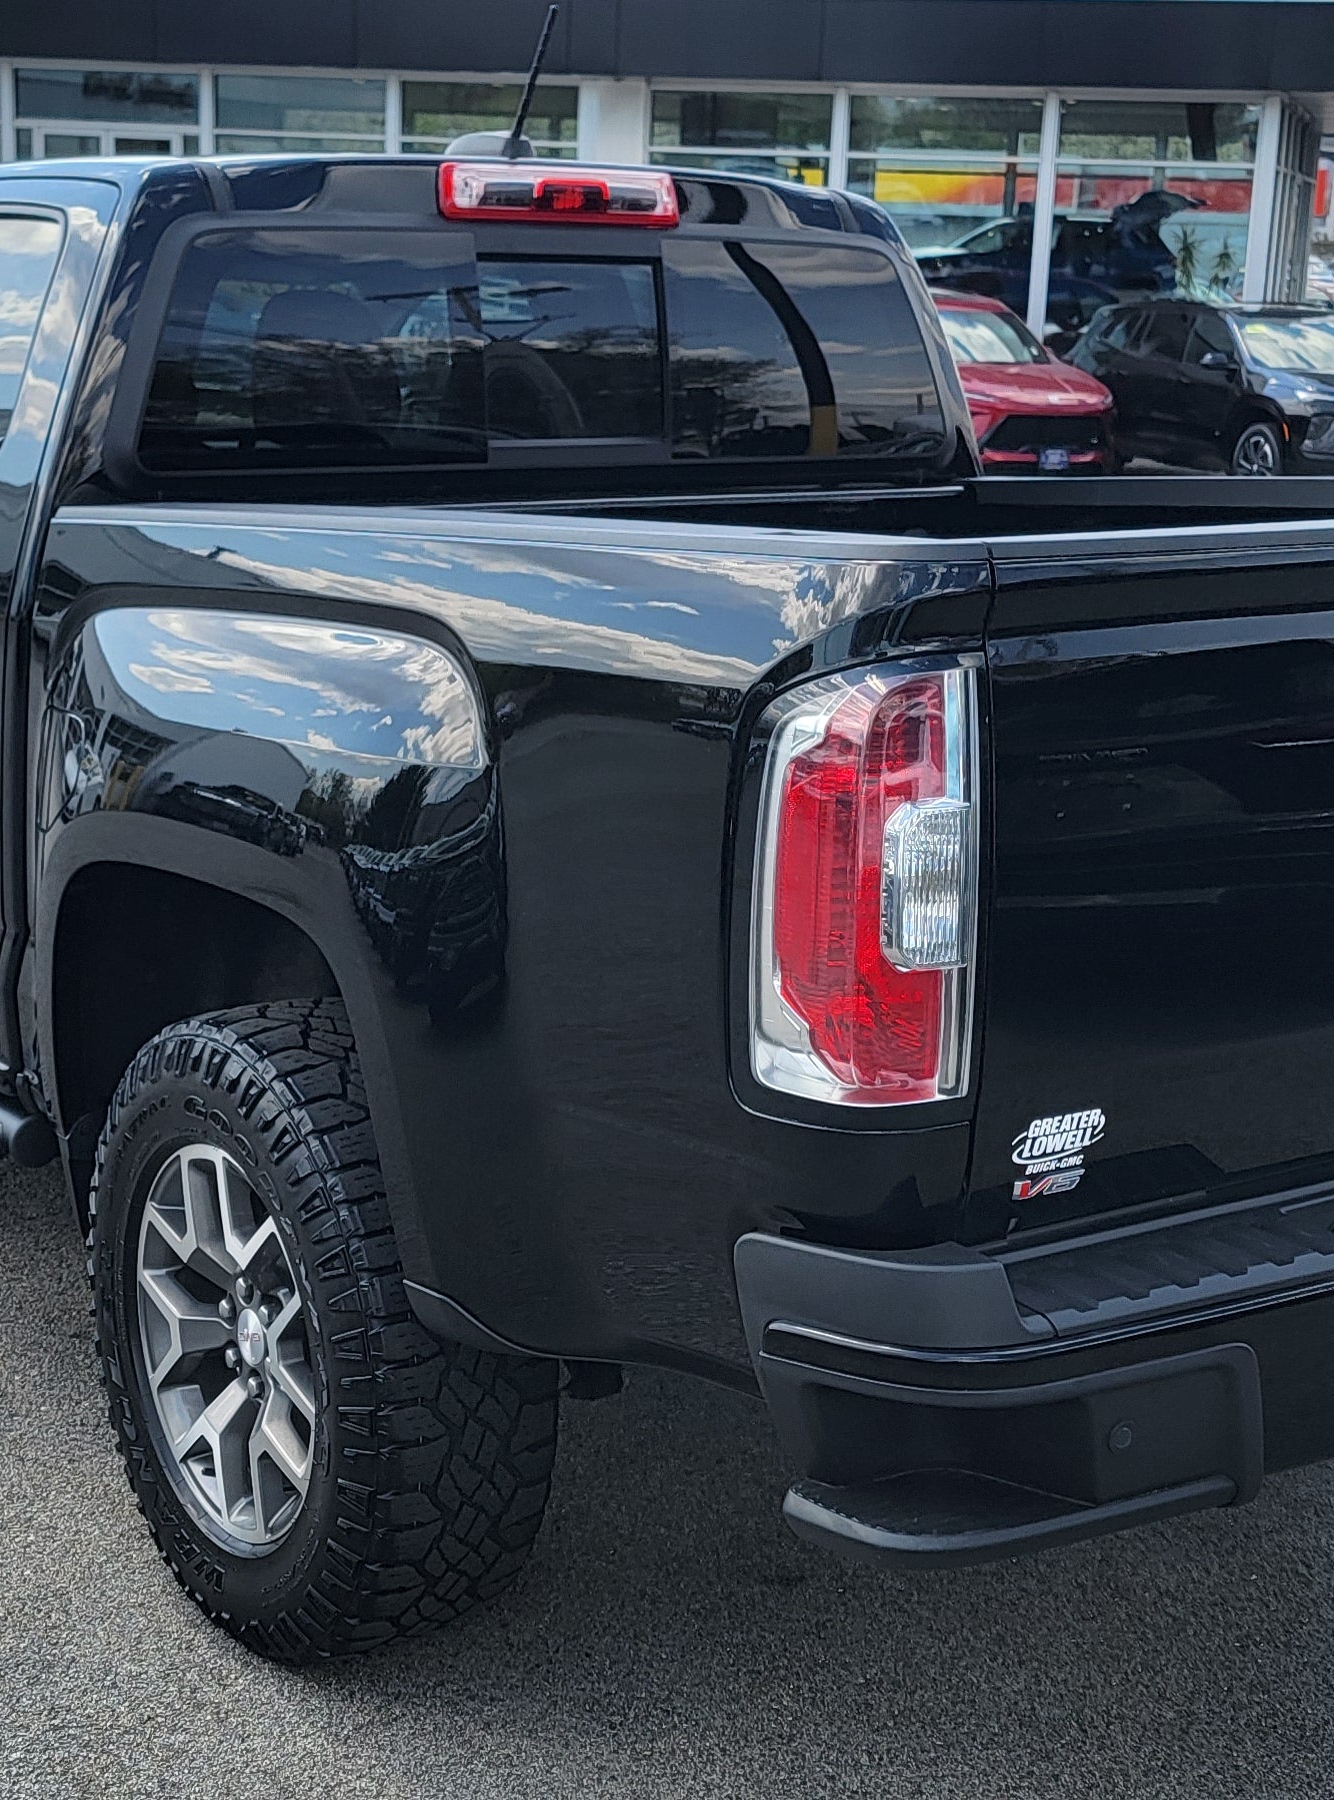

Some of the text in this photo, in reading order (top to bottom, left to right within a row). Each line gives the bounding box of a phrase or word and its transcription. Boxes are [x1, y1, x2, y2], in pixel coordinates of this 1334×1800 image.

[1027, 1108, 1102, 1138] GREATER
[1022, 1127, 1094, 1159] LOWELL
[1011, 1168, 1086, 1201] V6
